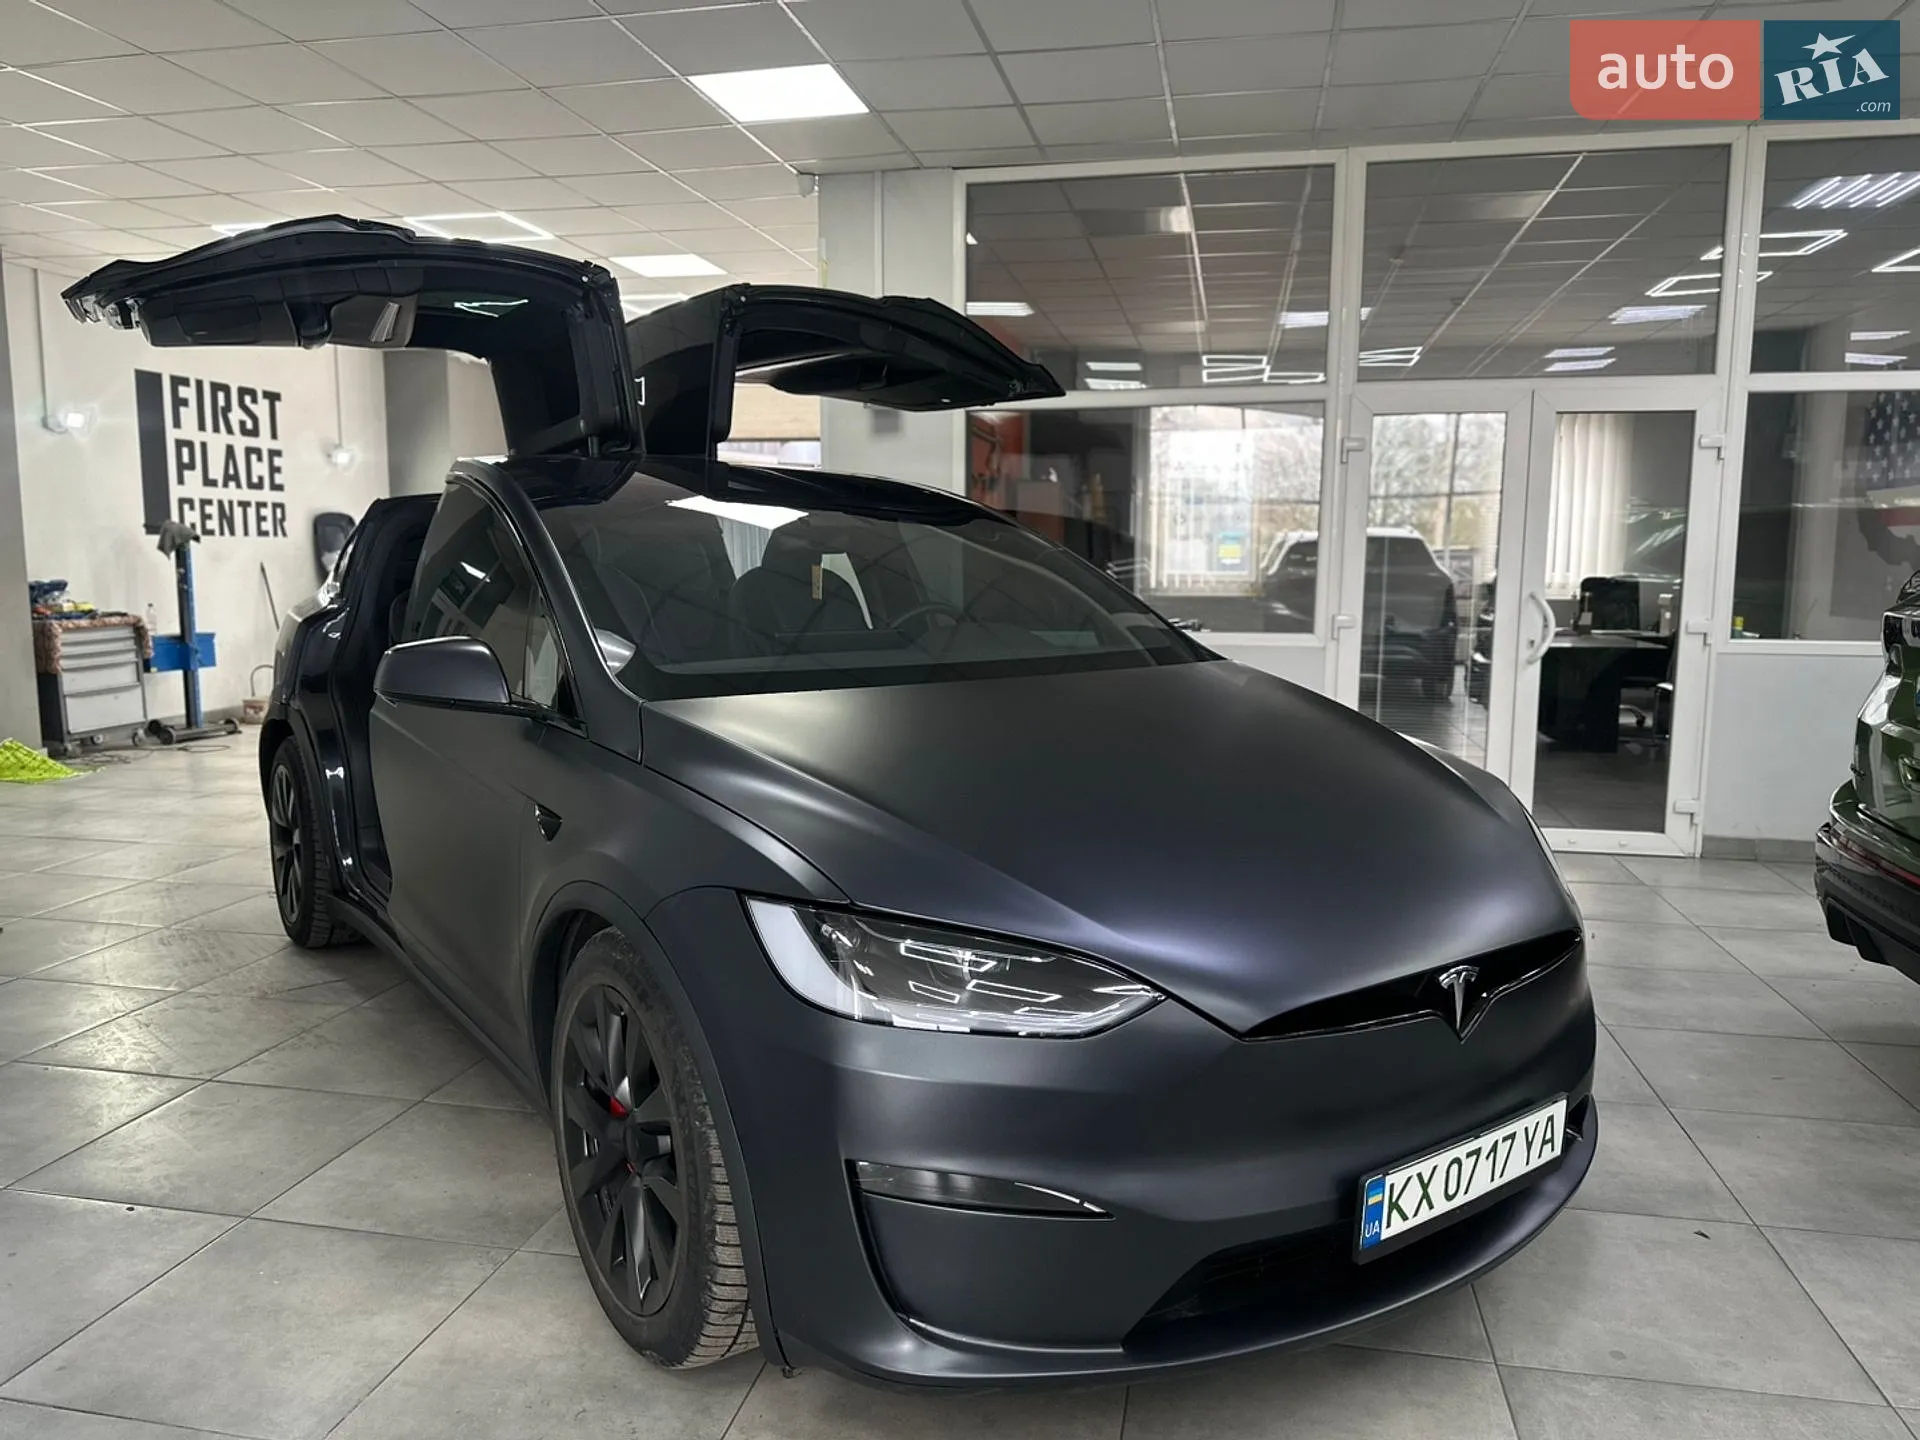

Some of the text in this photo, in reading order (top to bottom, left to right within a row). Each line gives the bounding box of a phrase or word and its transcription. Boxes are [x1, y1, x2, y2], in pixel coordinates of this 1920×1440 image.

[169, 374, 282, 440] FIRST
[174, 437, 285, 492] PLACE
[178, 497, 288, 538] CENTER
[1386, 1164, 1438, 1229] KX
[1364, 1220, 1380, 1238] UA
